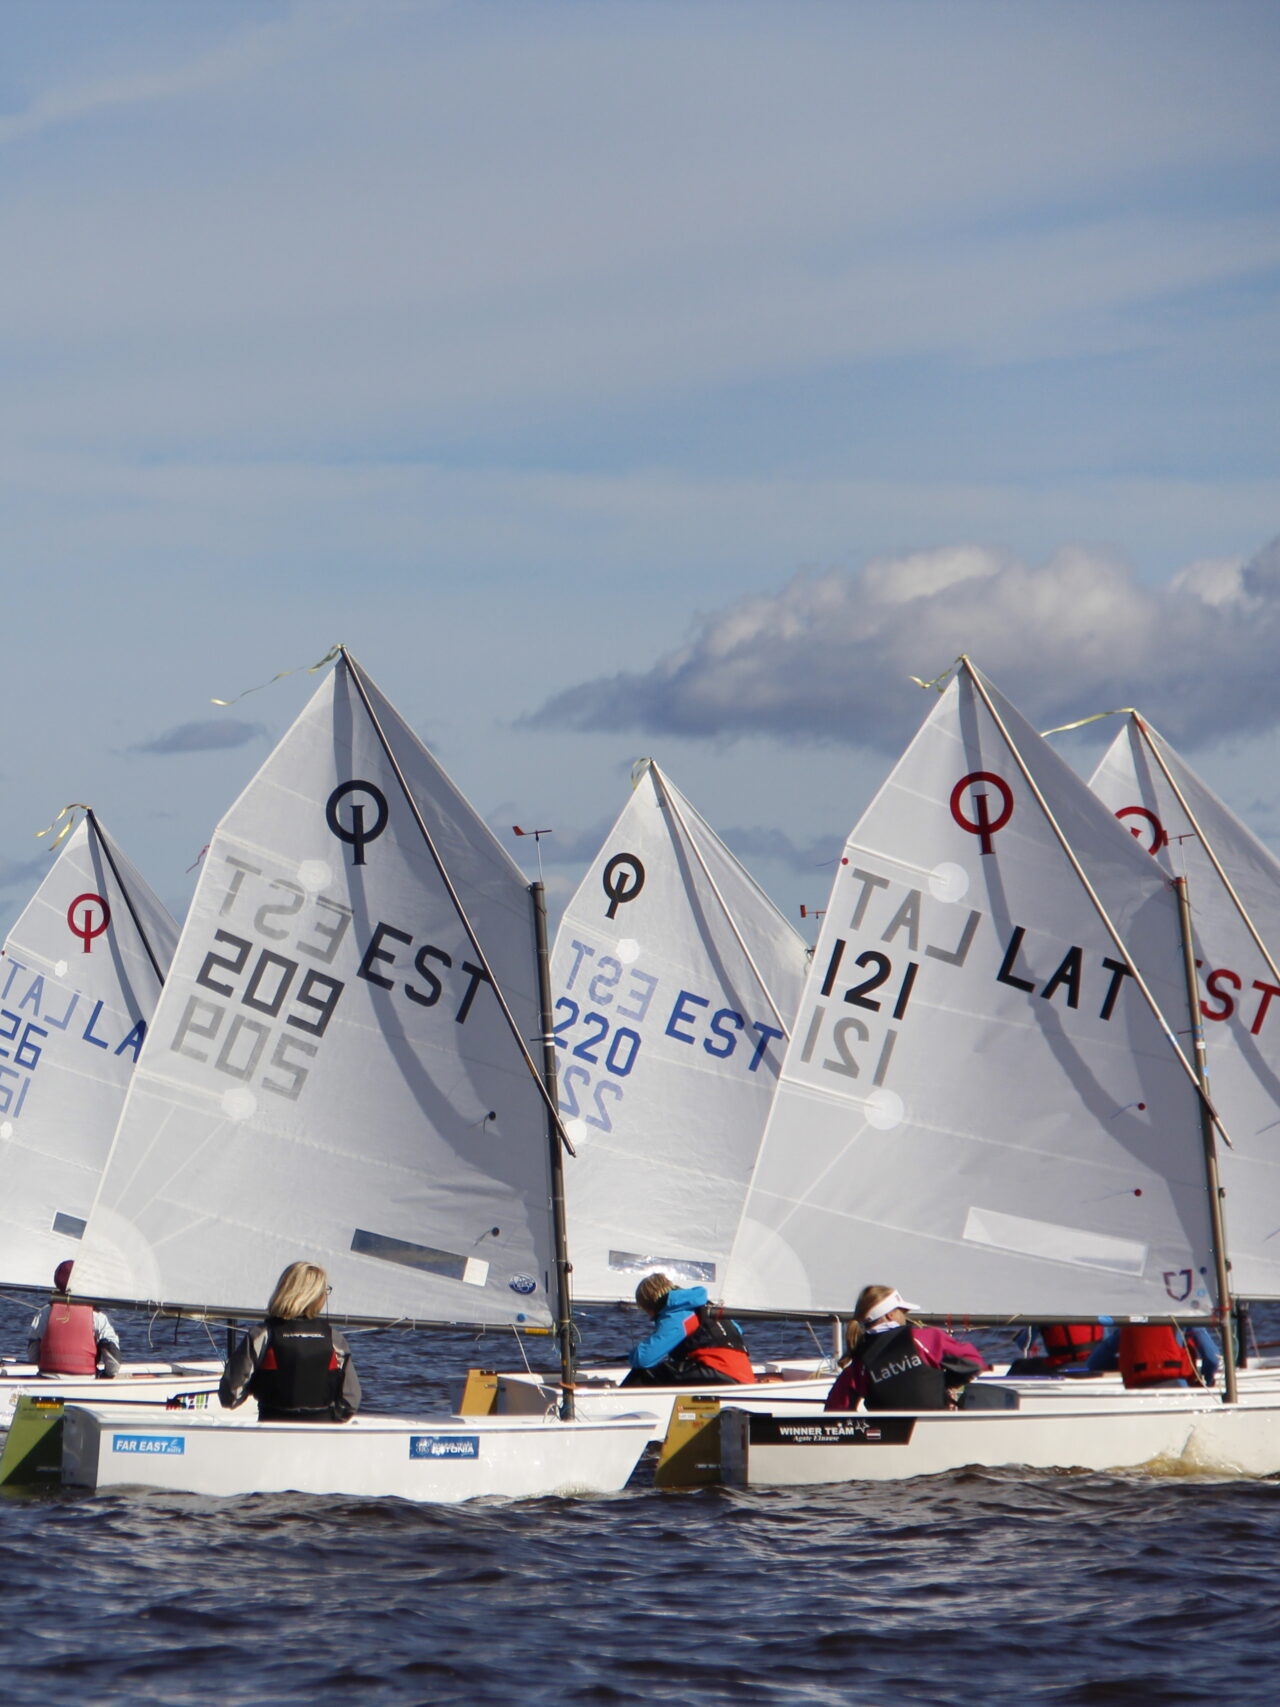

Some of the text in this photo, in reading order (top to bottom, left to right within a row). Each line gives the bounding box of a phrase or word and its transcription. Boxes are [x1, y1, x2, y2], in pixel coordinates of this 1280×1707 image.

[196, 928, 345, 1037] 209
[356, 921, 493, 1024] EST
[821, 939, 919, 1021] 121
[996, 926, 1140, 1021] LAT
[1195, 959, 1280, 1035] ST
[82, 999, 148, 1064] LA
[553, 997, 641, 1077] 220
[665, 990, 784, 1072] EST
[870, 1355, 922, 1383] Latvia
[116, 1440, 136, 1450] FAR
[140, 1441, 168, 1452] EAST
[780, 1426, 854, 1435] WINNER TEAM
